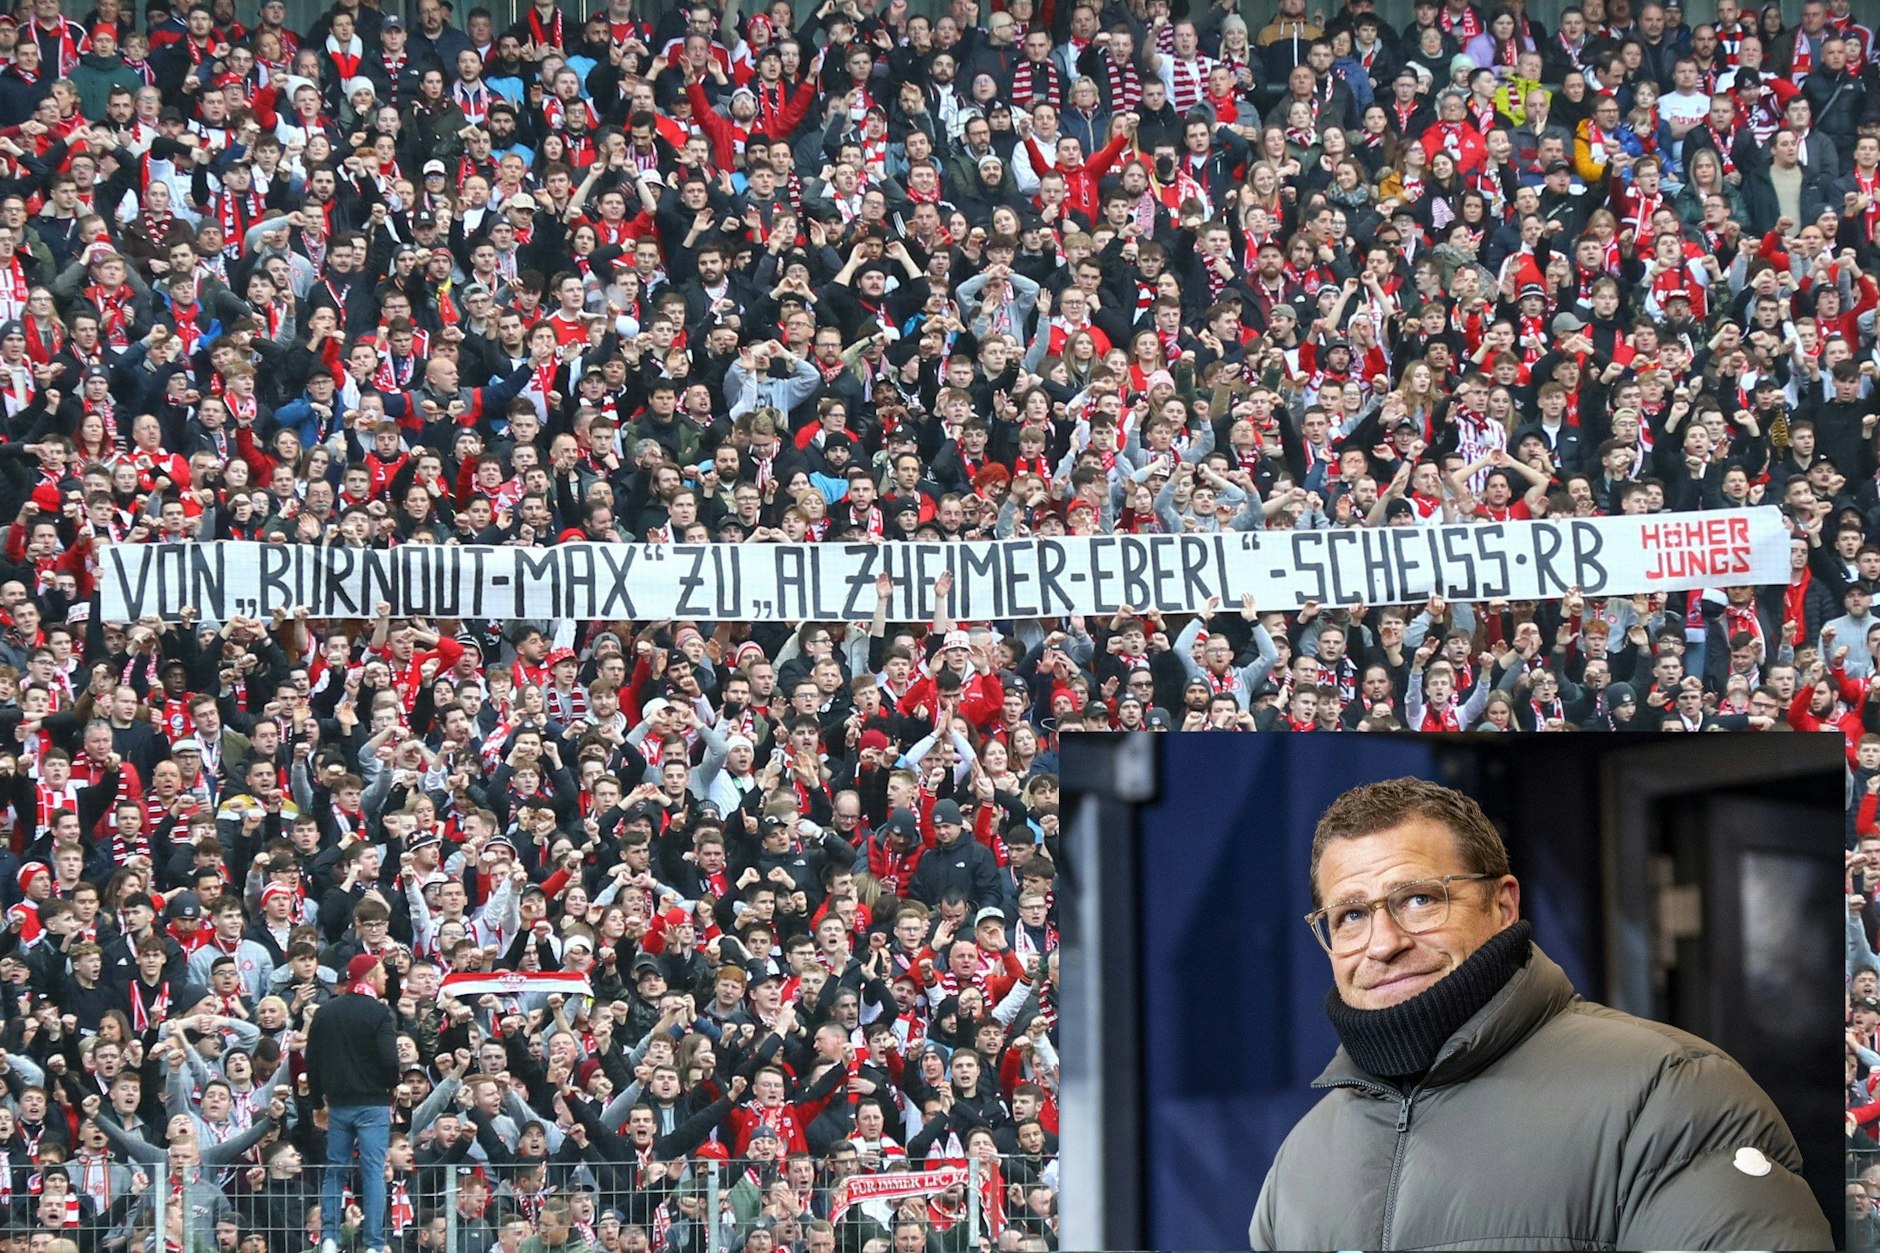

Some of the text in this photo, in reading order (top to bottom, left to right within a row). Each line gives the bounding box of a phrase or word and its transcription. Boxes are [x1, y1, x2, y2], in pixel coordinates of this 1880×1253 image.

[1641, 518, 1749, 549] HÖHER
[1646, 547, 1750, 579] JUNGS
[110, 542, 225, 621] VON
[673, 546, 741, 617] ZU
